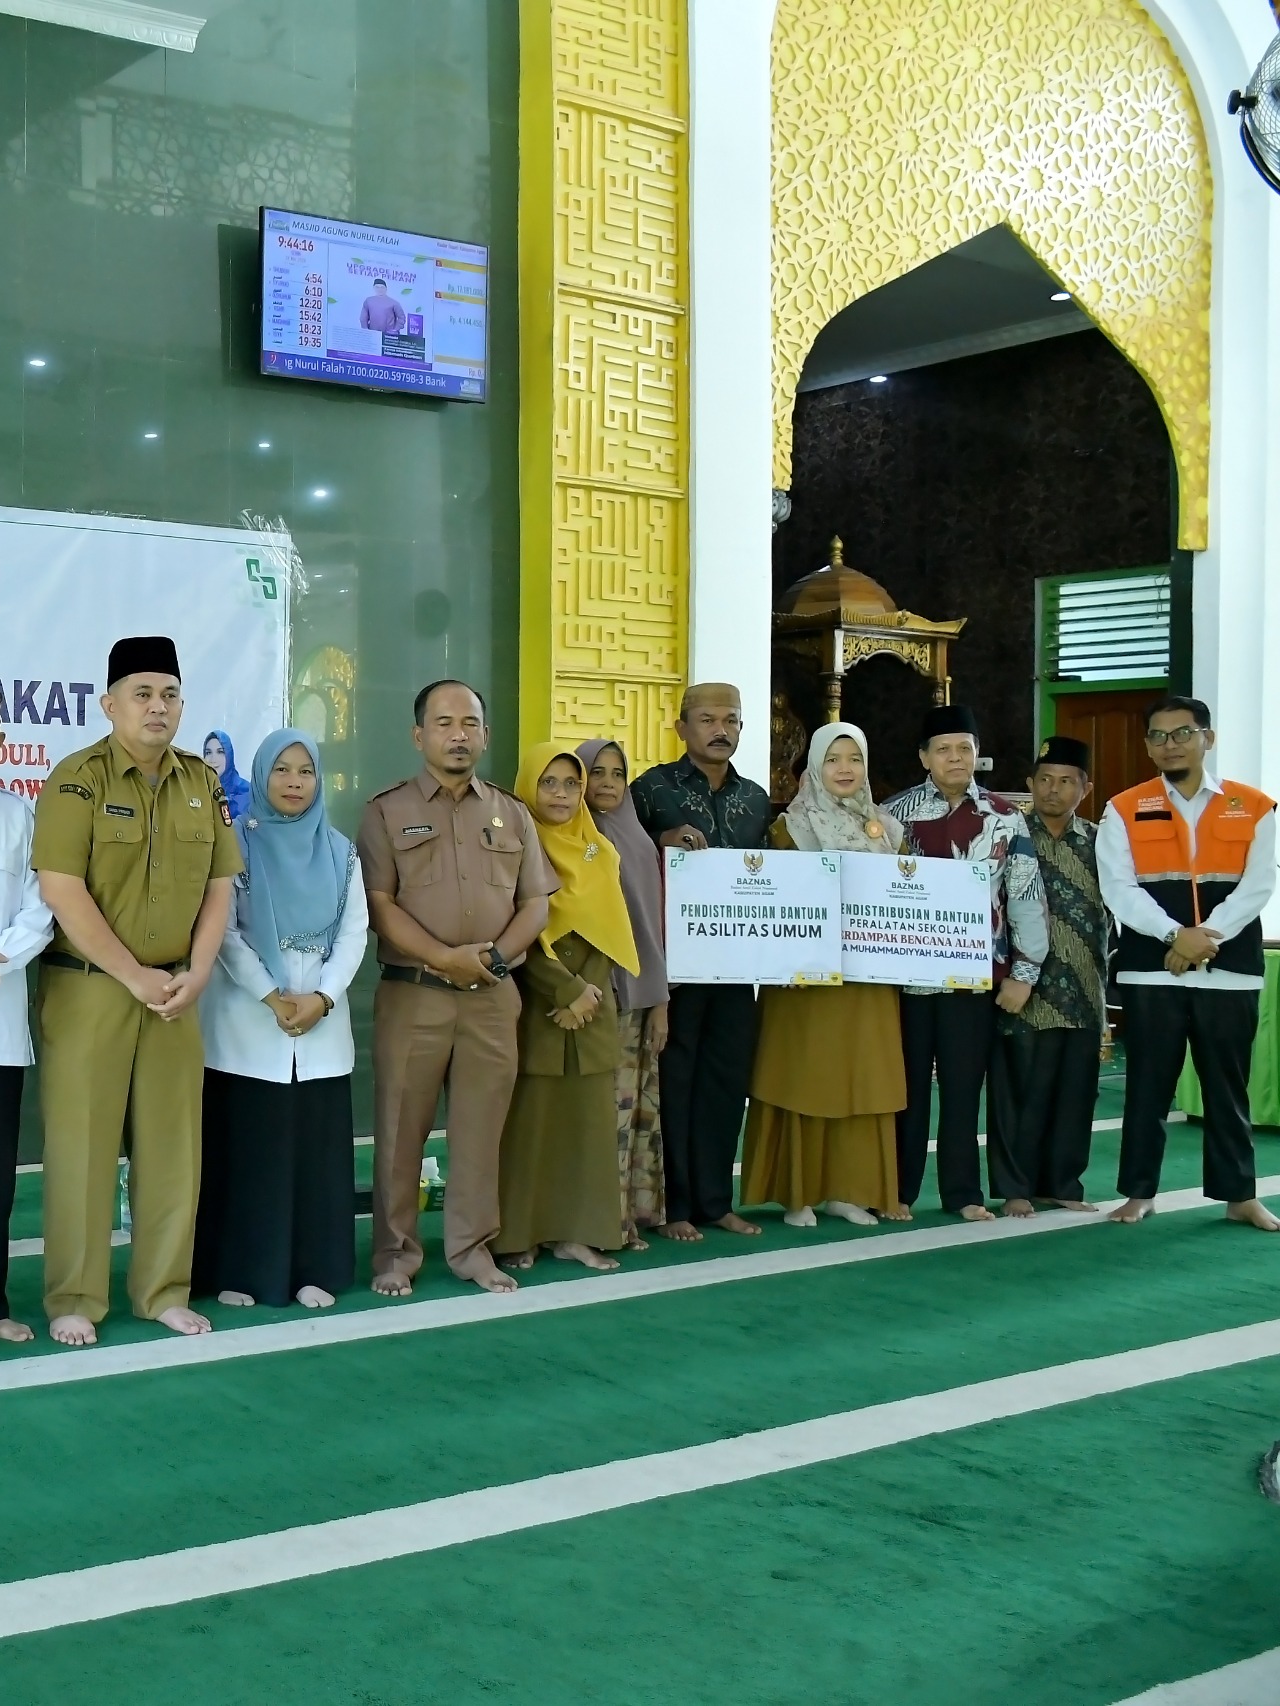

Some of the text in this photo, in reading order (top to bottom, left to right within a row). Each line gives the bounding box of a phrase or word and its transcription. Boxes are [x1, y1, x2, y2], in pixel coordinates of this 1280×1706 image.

[292, 221, 400, 246] MASJID AGUNG NURUL FALAH
[278, 235, 314, 252] 9:44:16
[305, 272, 322, 284] 4:54
[304, 285, 322, 297] 6:10
[299, 298, 322, 310] 12:20
[299, 310, 322, 323] 15:42
[299, 323, 322, 335] 18:23
[299, 336, 322, 348] 19:35
[295, 358, 319, 371] Nurul
[321, 362, 344, 374] Falah
[347, 366, 423, 385] 7100.0220.59798-3
[426, 375, 446, 387] Bank
[892, 882, 925, 890] BAZNAS
[681, 904, 828, 920] PENDISTRIBUSIAN BANTUAN
[841, 903, 984, 925] ENDISTRIBUSIAN BANTUAN
[687, 922, 822, 938] FASILITAS UMUM
[850, 918, 967, 935] PERALATAN SEKOLAH
[900, 933, 953, 948] BENCANA
[955, 938, 986, 949] ALAM
[850, 944, 932, 958] MUHAMMADIYYAH
[933, 949, 972, 960] SALAREH
[974, 953, 988, 961] AIA
